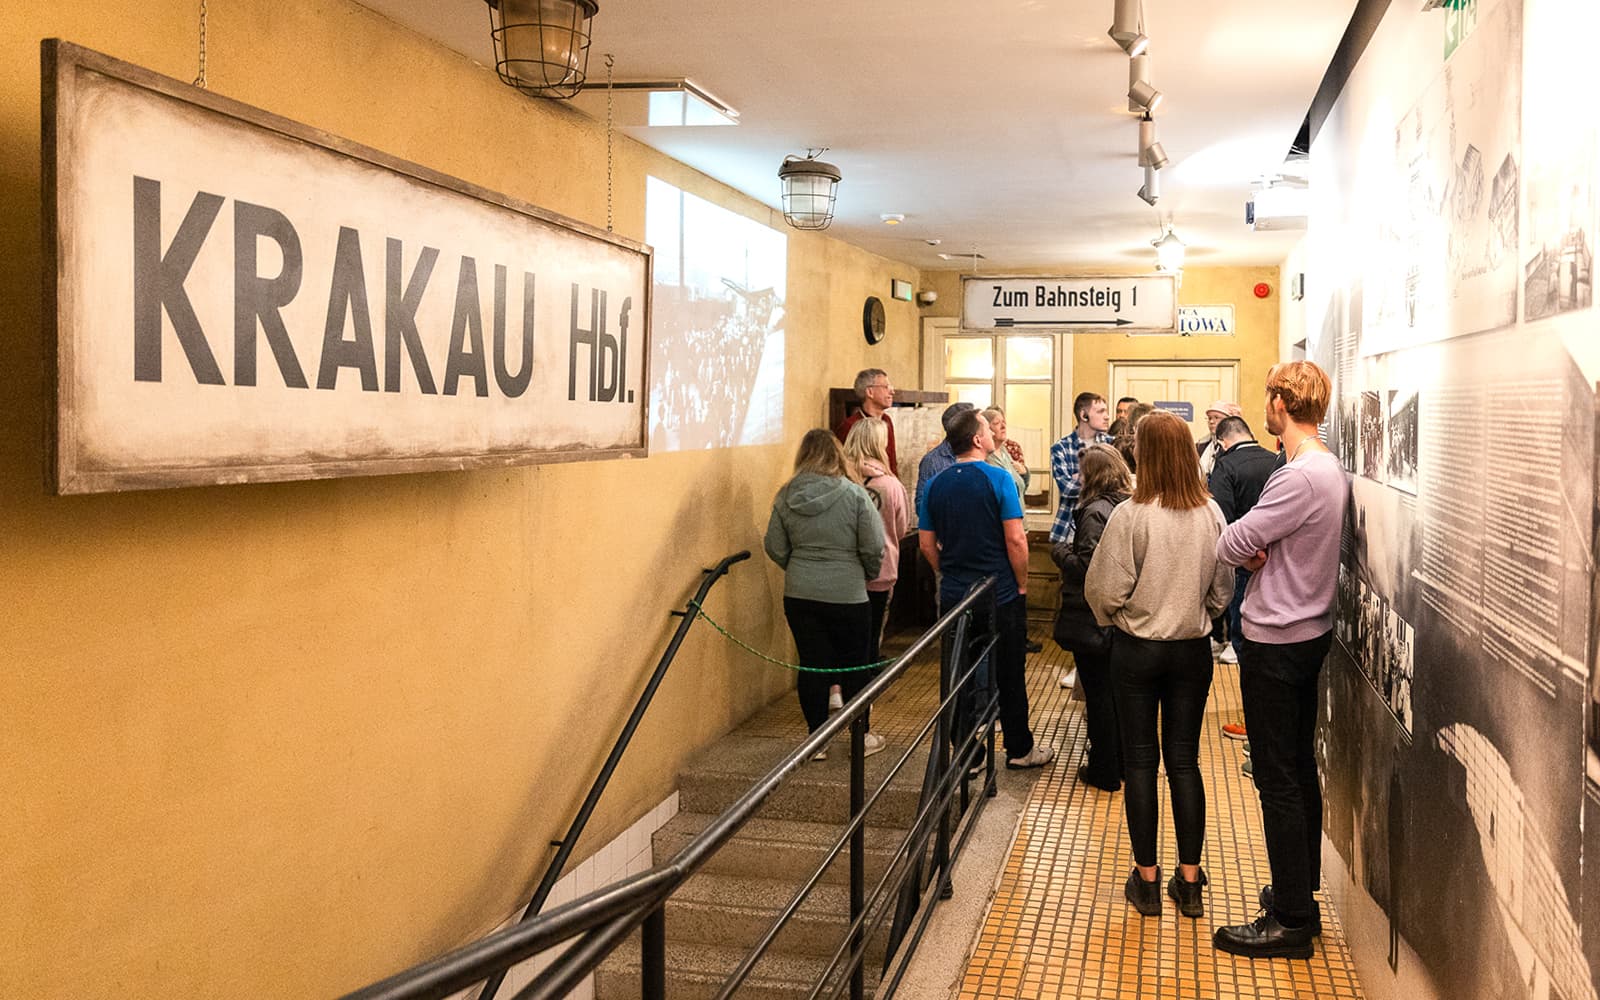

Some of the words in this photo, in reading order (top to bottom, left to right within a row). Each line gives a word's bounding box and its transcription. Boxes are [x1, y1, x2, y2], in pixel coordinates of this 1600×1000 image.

[133, 175, 536, 399] KRAKAU
[568, 282, 635, 404] Hbf.
[993, 286, 1029, 307] Zum
[1035, 286, 1121, 313] Bahnsteig
[1132, 286, 1137, 306] 1
